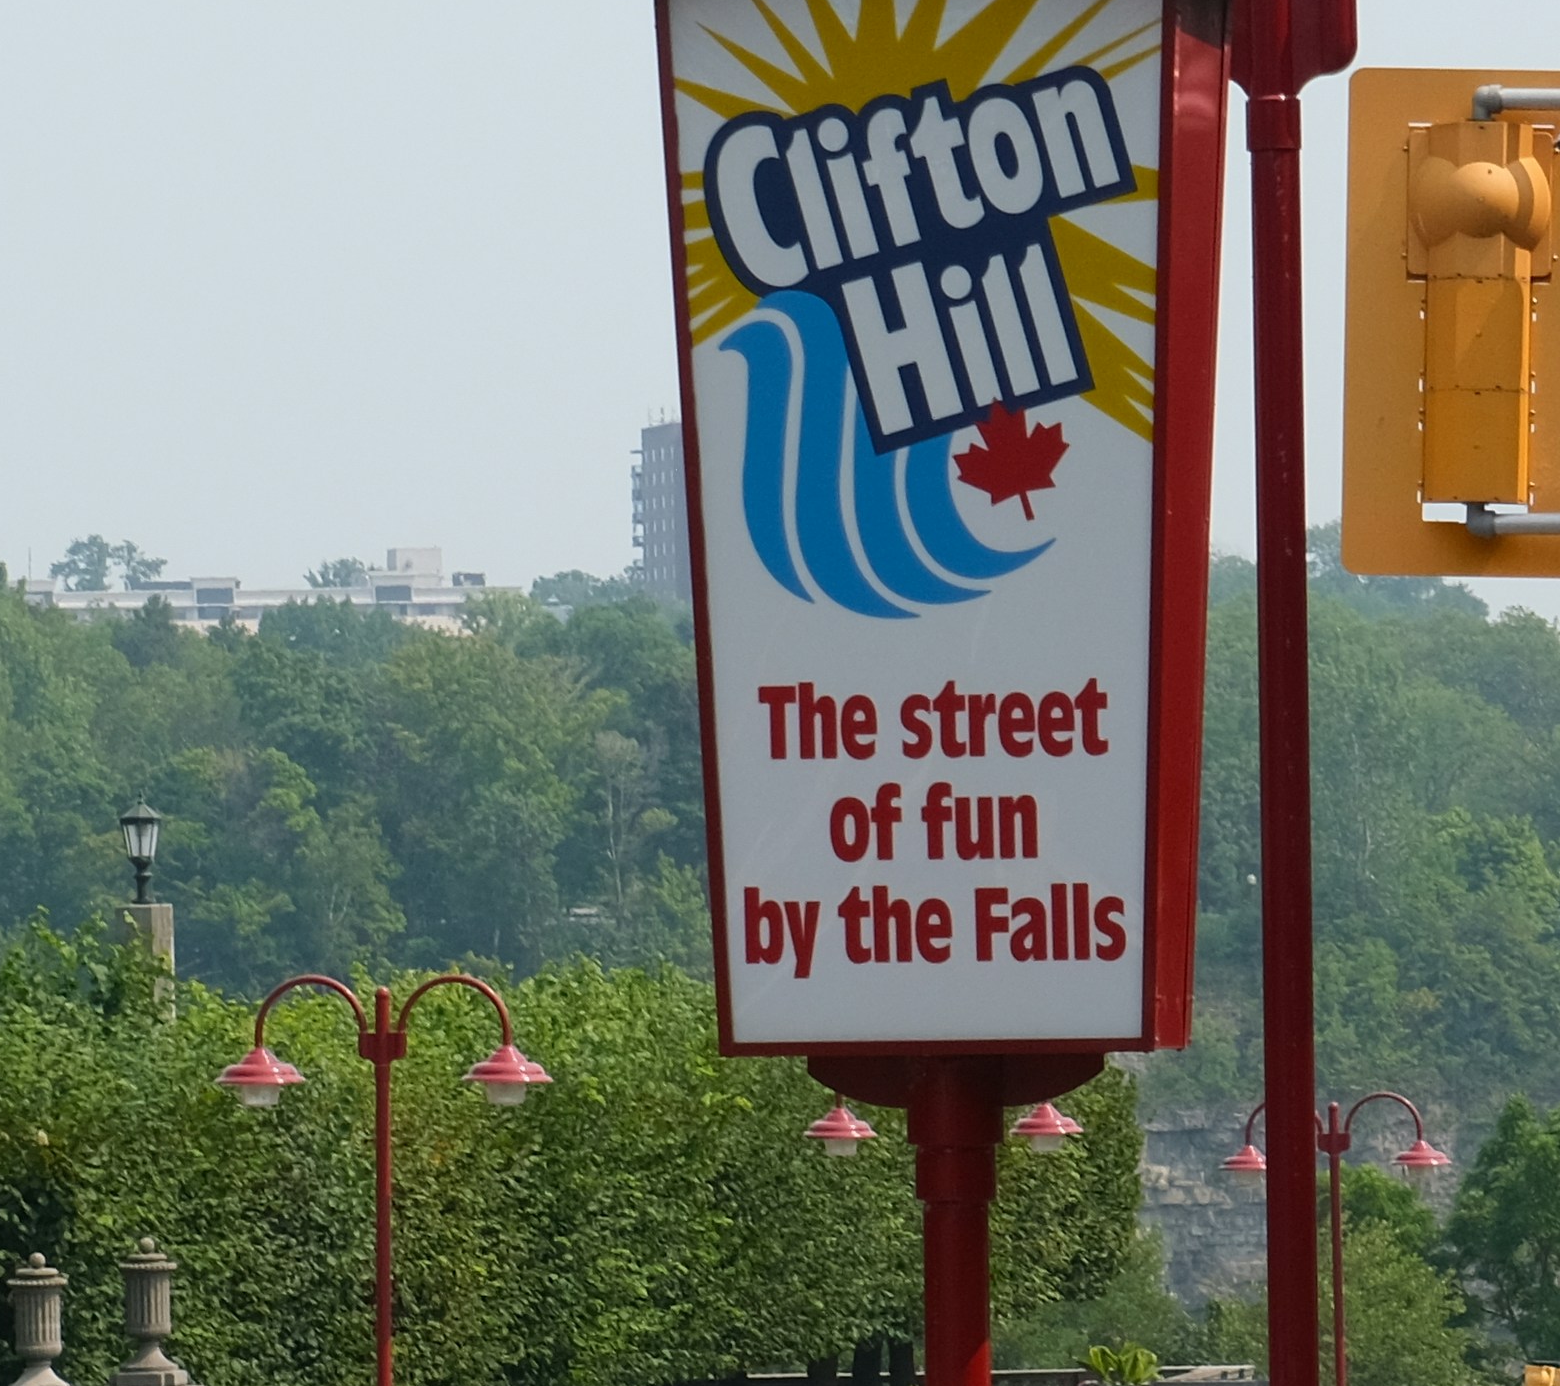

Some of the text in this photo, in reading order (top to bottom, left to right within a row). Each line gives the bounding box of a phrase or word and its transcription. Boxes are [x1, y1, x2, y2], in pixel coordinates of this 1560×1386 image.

[717, 78, 1121, 288] Clifton
[841, 242, 1078, 438] Hill
[758, 678, 1109, 760] The street
[830, 782, 1039, 862] of fun
[743, 883, 1127, 979] by the Falls
